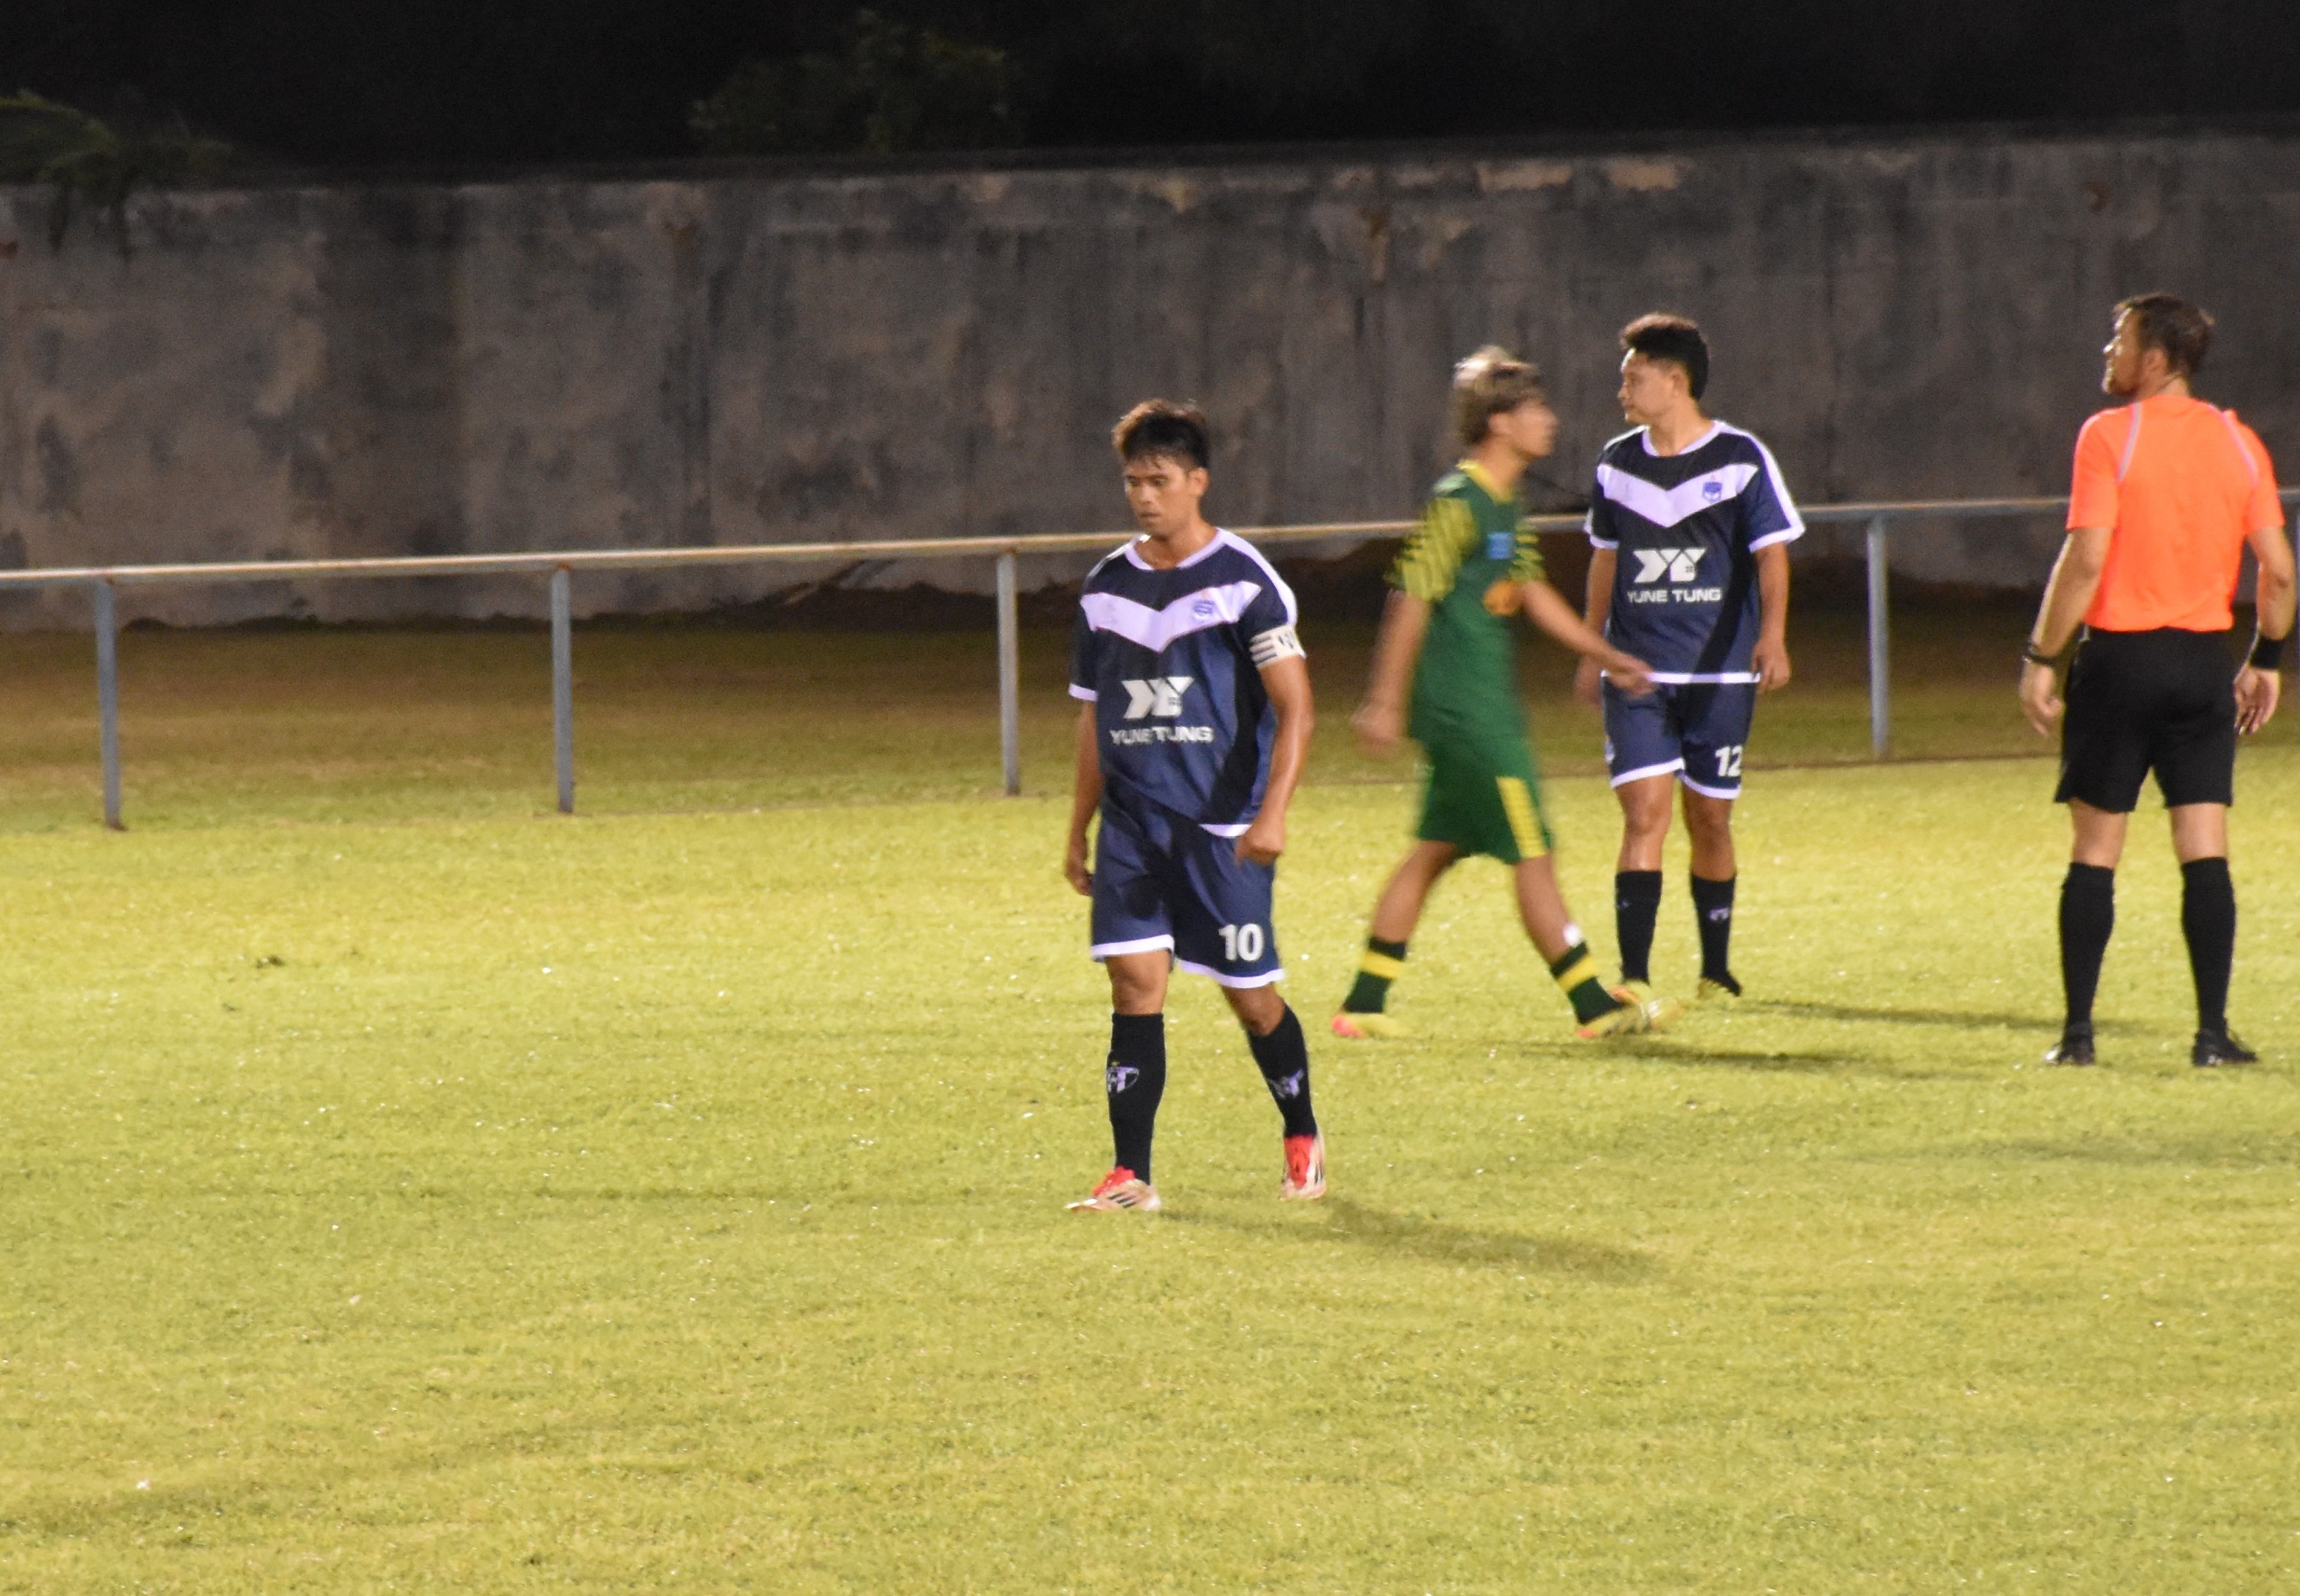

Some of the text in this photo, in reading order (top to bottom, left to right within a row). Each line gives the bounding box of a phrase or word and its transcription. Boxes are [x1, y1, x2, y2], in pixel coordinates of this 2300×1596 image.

[1627, 588, 1721, 603] YUNE TUNG
[1110, 725, 1214, 745] YUNE TUNG
[1715, 745, 1743, 776] 12
[1218, 924, 1263, 961] 10
